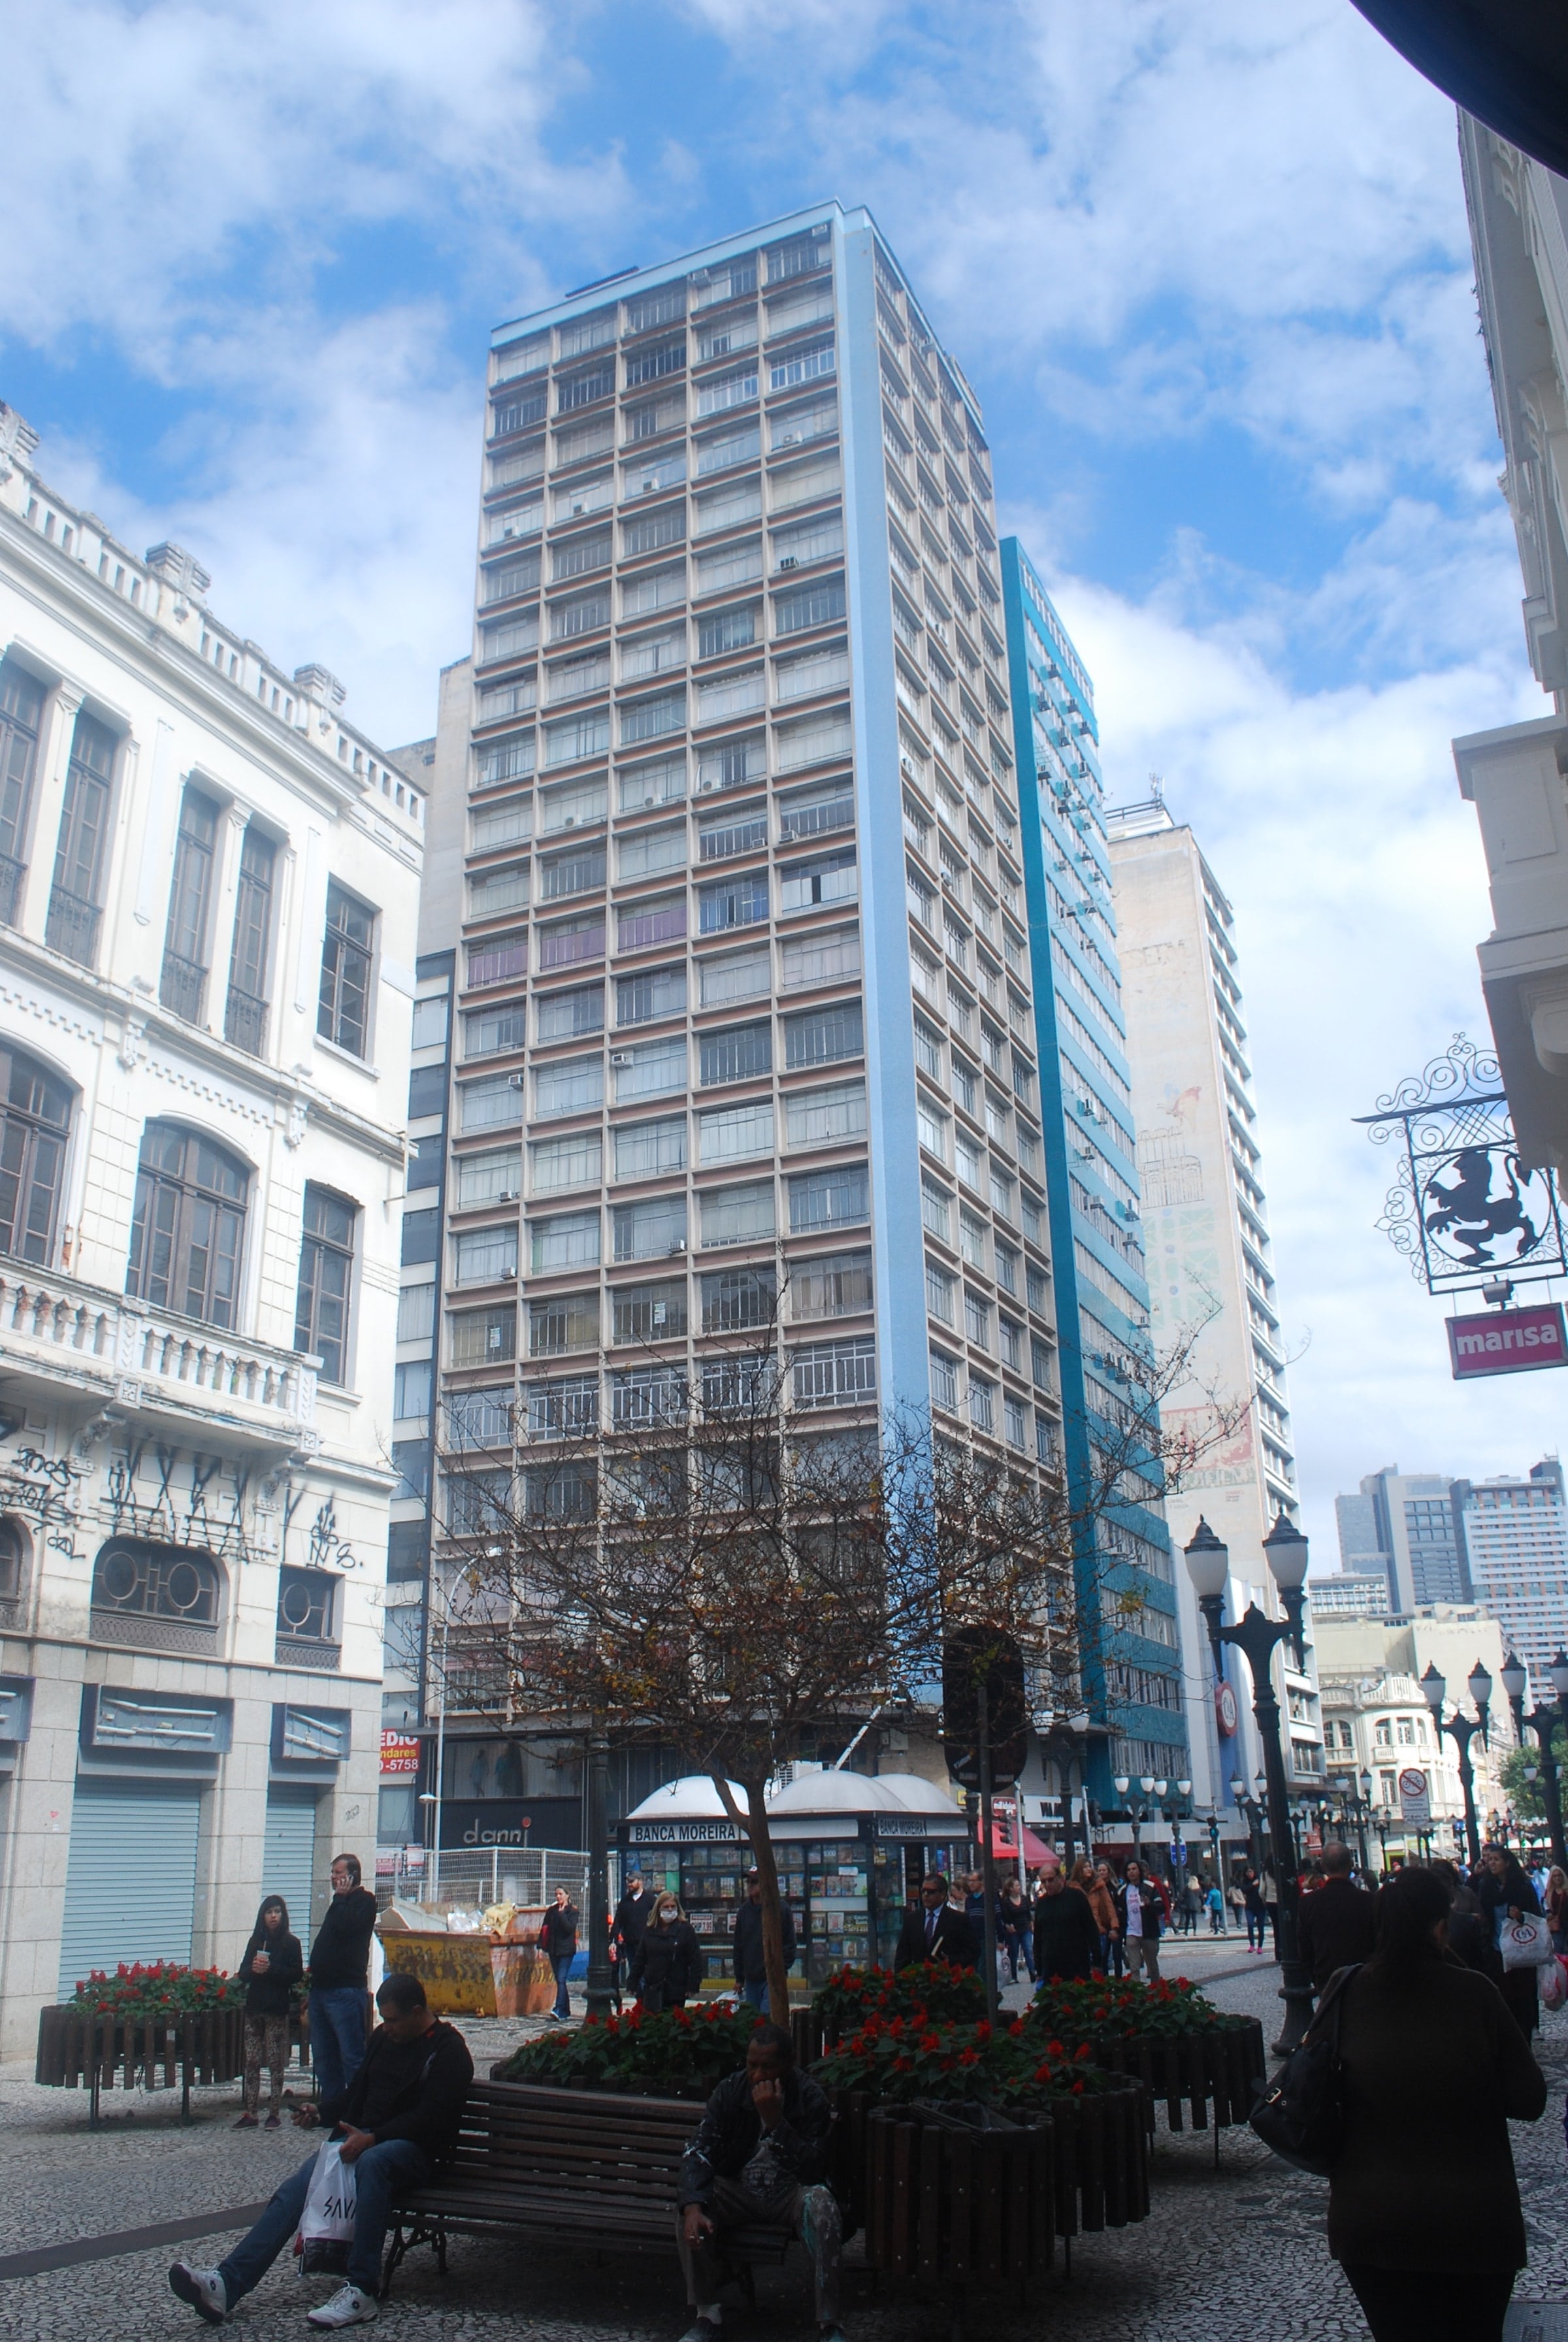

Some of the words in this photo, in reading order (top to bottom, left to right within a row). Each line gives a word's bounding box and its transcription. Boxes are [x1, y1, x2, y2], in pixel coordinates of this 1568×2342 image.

[1456, 1324, 1558, 1355] marisa
[463, 1816, 531, 1850] danni
[635, 1827, 675, 1841] BANCA
[679, 1825, 736, 1840] MOREIRA
